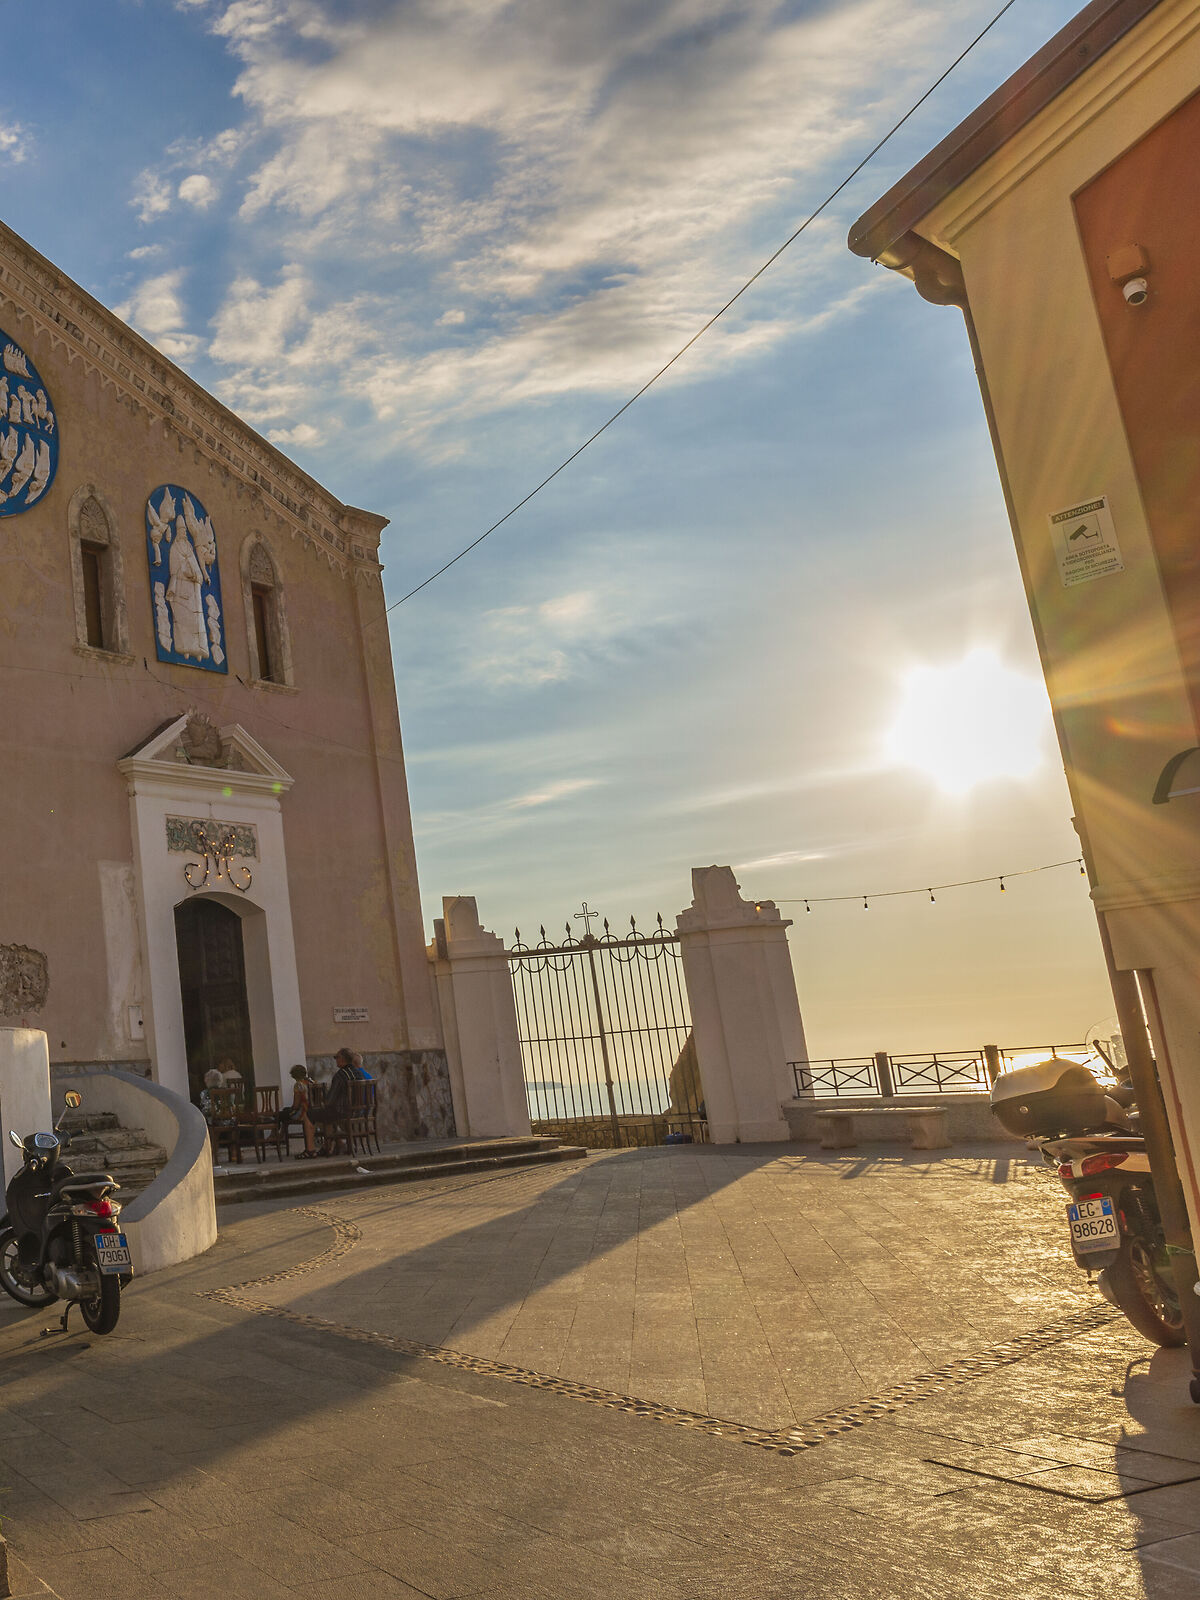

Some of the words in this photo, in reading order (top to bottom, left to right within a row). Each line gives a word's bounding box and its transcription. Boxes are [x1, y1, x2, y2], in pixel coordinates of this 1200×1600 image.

[1078, 1203, 1095, 1218] EG
[1073, 1218, 1114, 1238] 98628
[103, 1236, 115, 1247] DH
[100, 1250, 128, 1262] 79061
